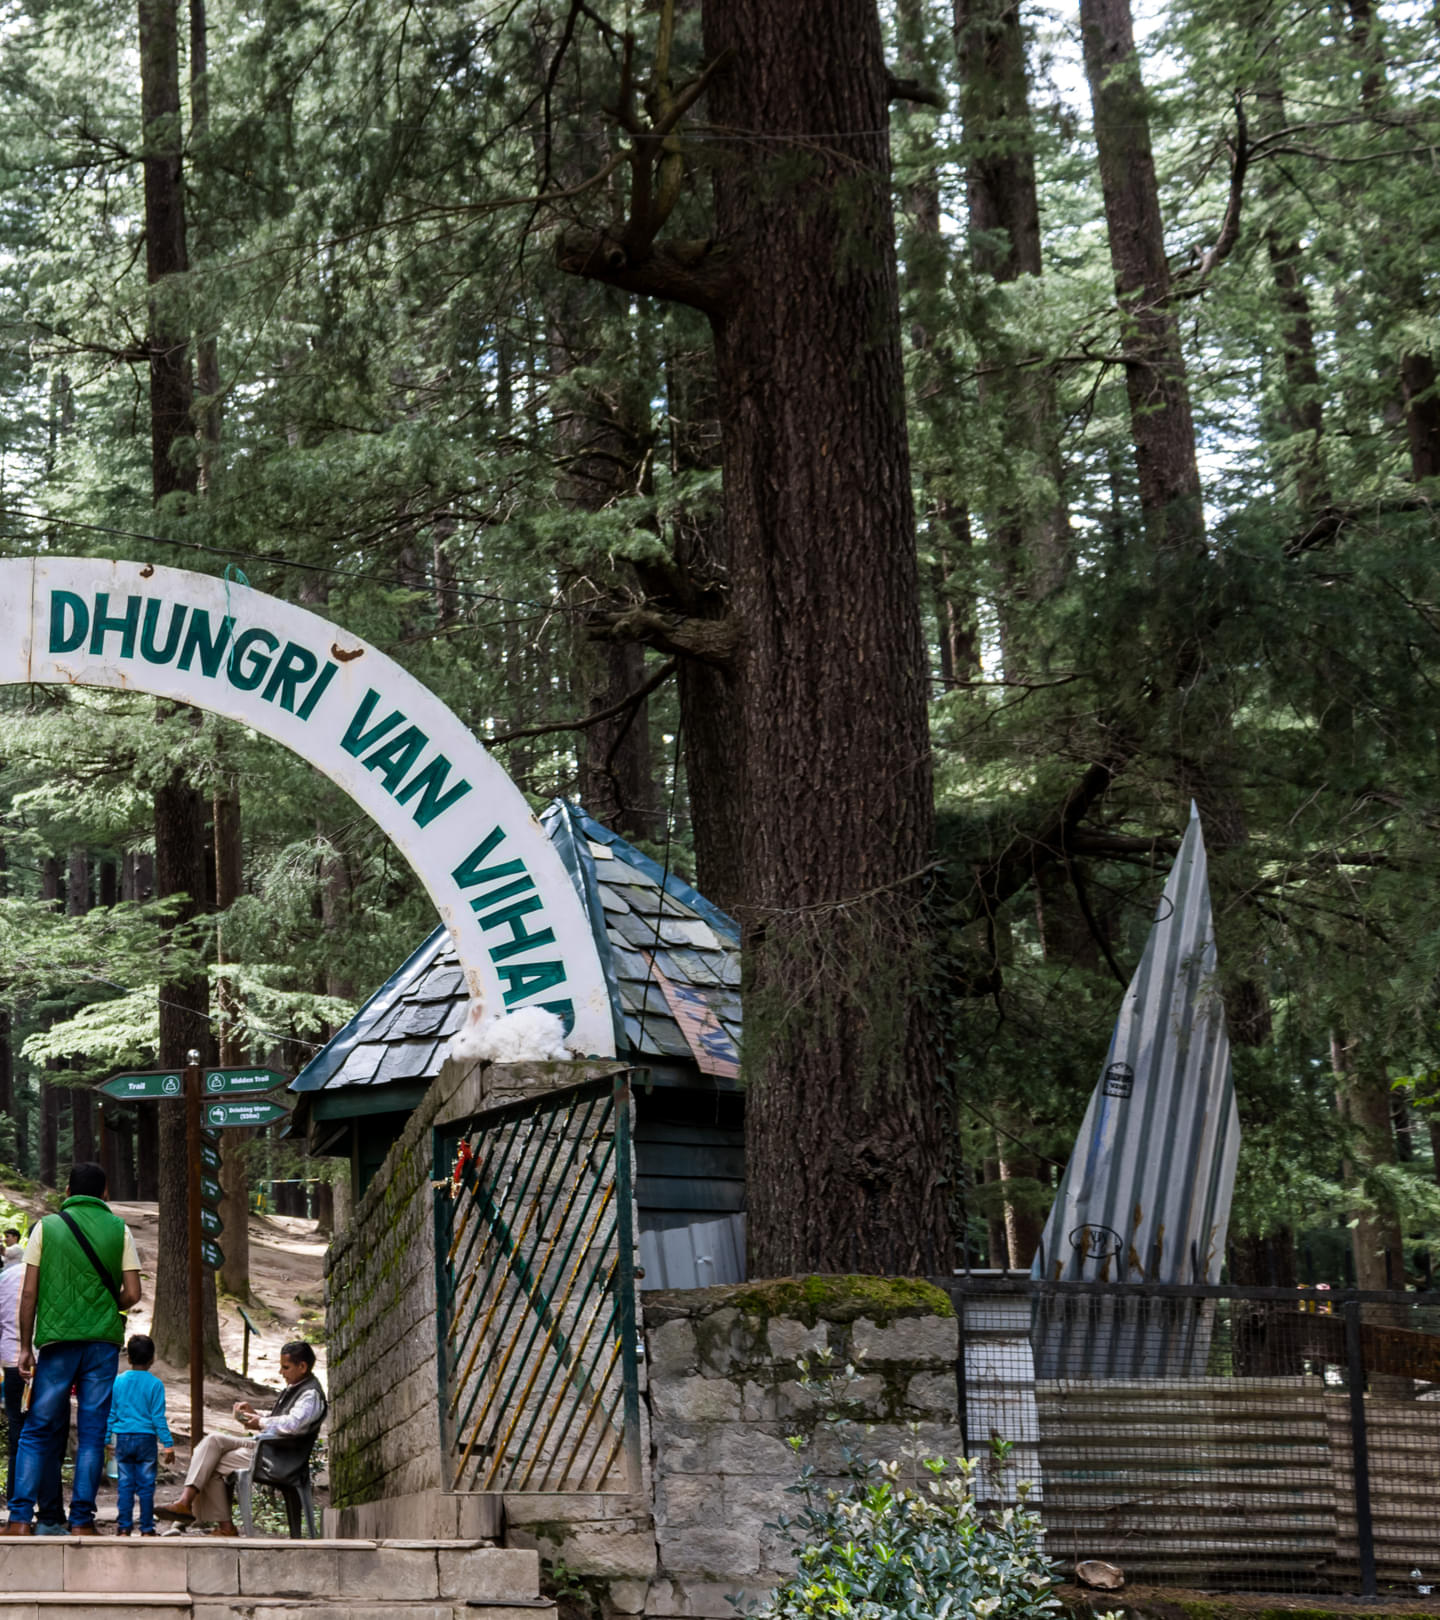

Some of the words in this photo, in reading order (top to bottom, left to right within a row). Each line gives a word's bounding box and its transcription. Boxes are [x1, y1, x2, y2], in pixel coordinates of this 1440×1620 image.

[48, 589, 339, 721] DHUNGRI
[339, 688, 473, 829] VAN
[254, 1075, 270, 1083] Trail
[128, 1082, 146, 1090] Trail
